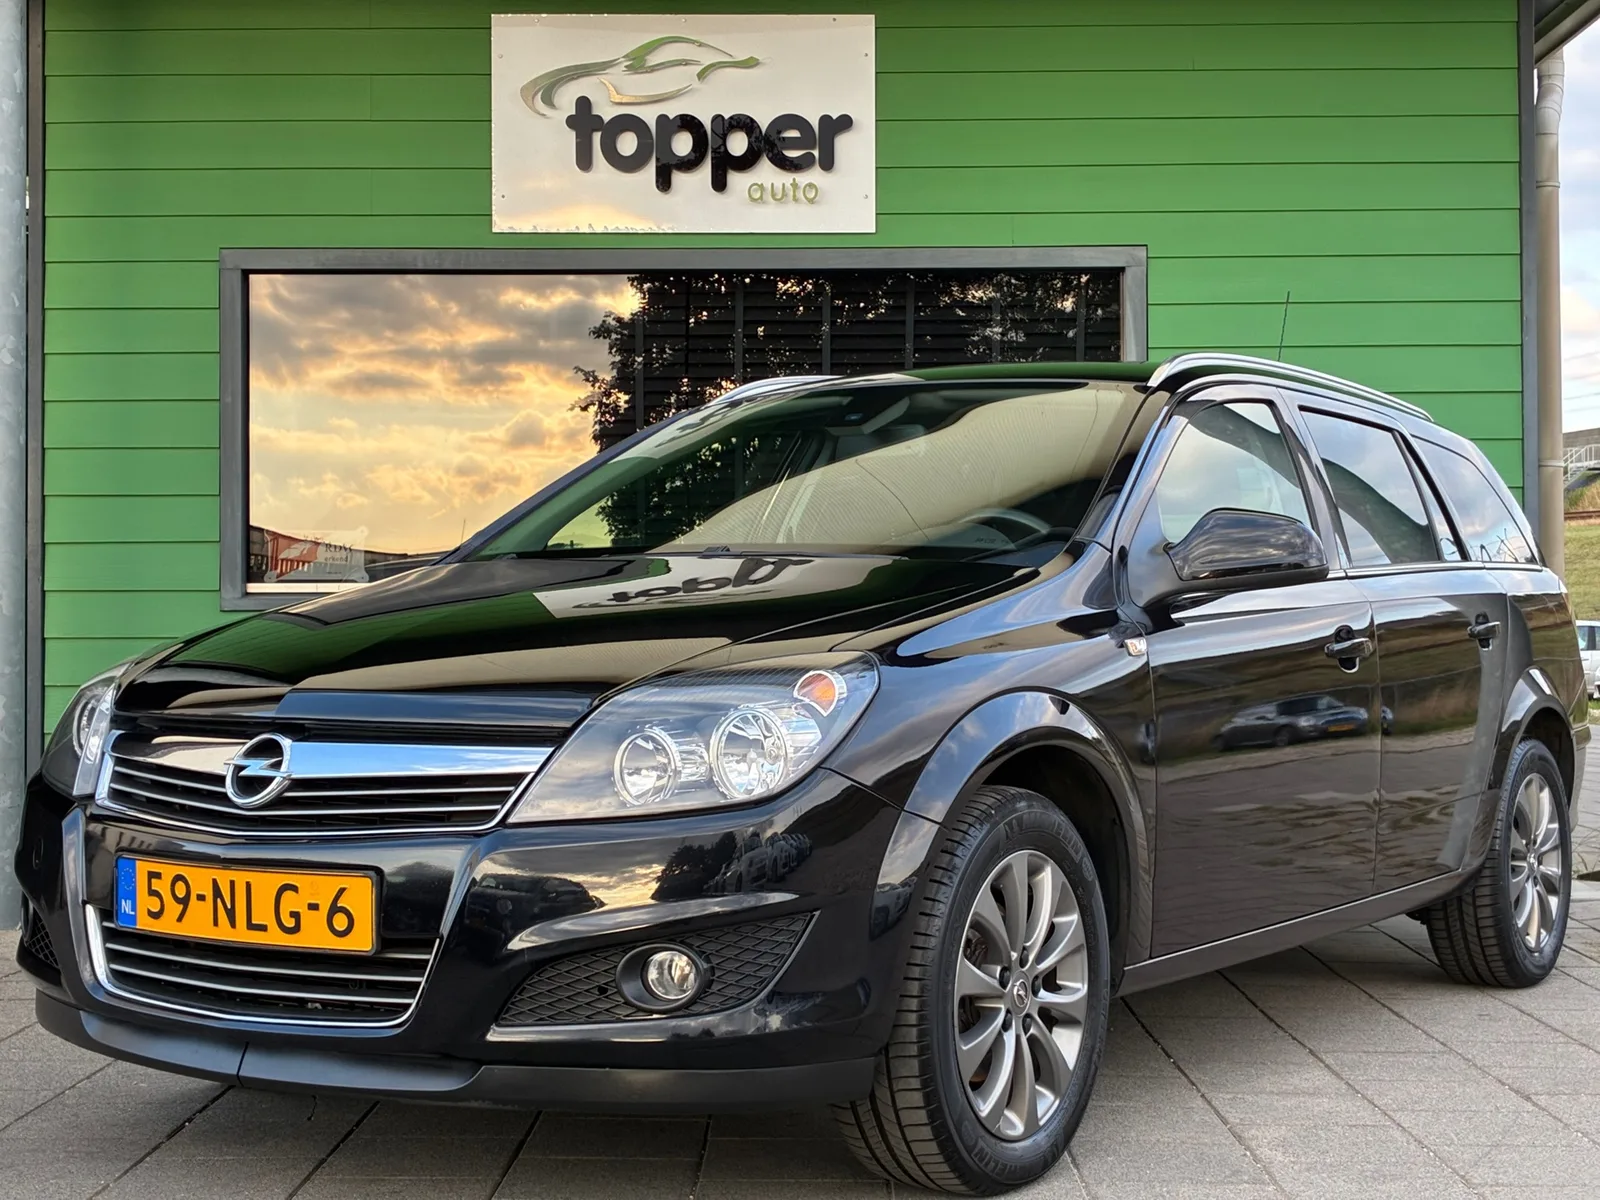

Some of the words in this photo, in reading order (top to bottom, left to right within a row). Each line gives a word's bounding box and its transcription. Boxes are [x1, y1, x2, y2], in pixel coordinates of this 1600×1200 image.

[565, 95, 853, 193] topper
[747, 178, 819, 204] auto
[121, 899, 135, 915] NL
[147, 870, 355, 938] 59-NLG-6
